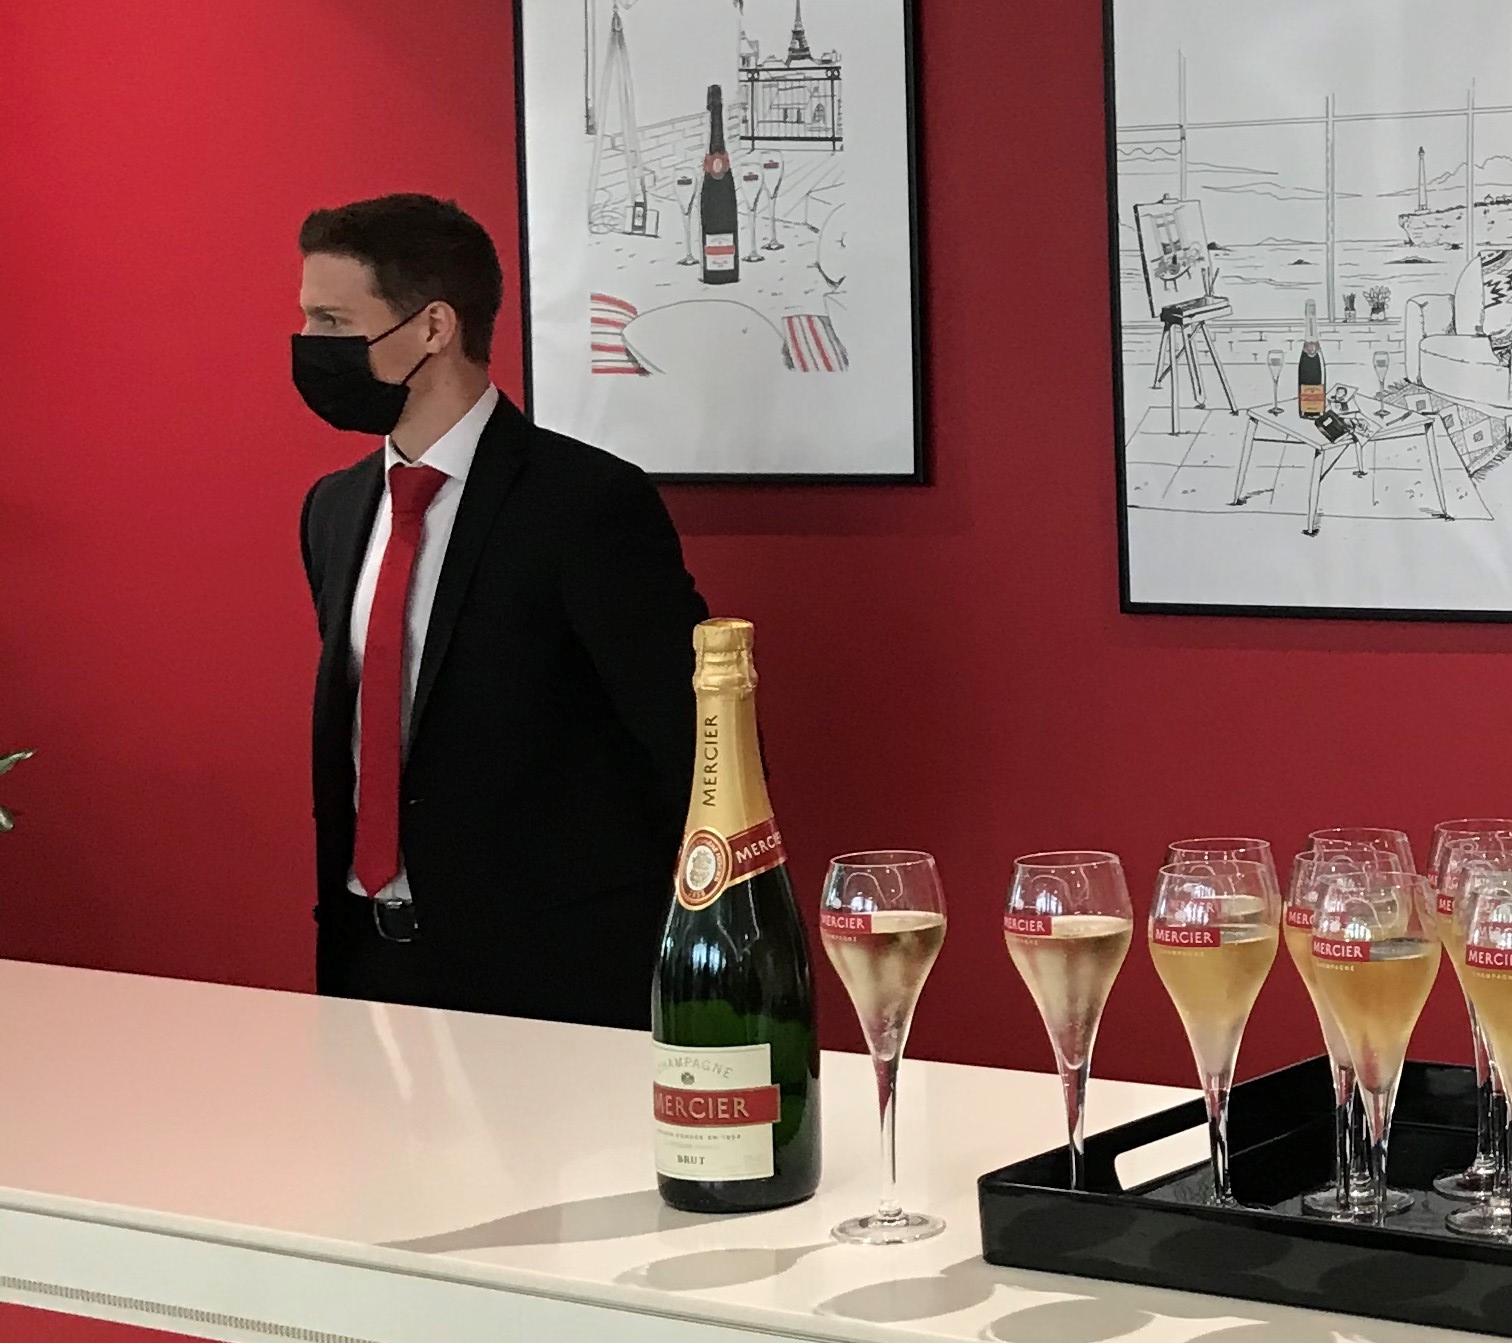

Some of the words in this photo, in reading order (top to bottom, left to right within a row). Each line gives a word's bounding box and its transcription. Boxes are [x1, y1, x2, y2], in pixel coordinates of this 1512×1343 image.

[702, 714, 719, 807] MERCIER
[735, 831, 781, 864] MERCIE
[1155, 928, 1214, 944] MERCIER
[1313, 940, 1363, 958] MERCIER
[654, 1092, 750, 1119] MERCIER
[677, 1154, 706, 1165] BRUT
